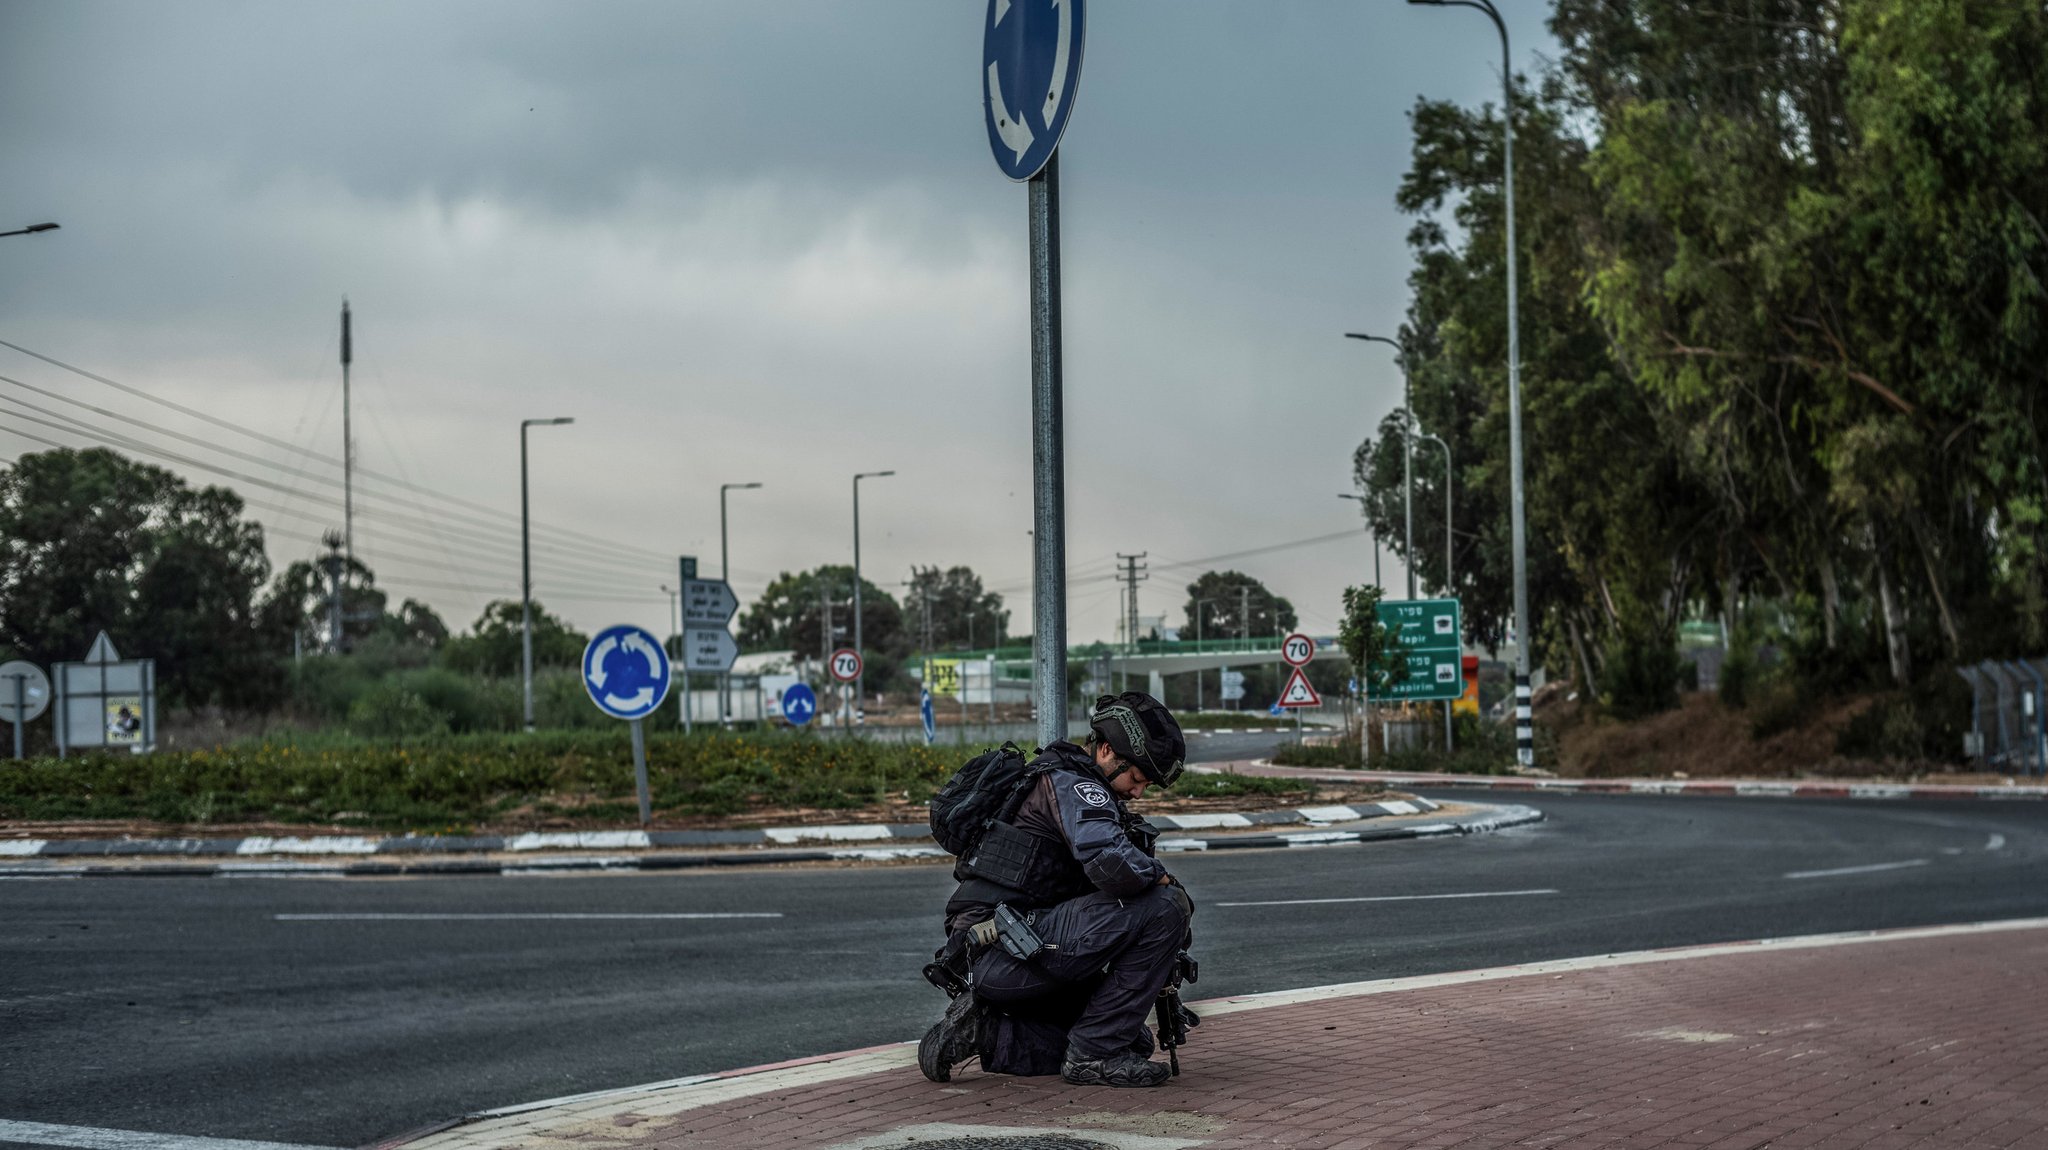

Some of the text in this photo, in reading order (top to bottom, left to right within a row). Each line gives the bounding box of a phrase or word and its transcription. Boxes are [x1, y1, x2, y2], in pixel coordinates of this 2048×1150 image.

[1398, 606, 1423, 617] ספיר
[1288, 642, 1309, 658] 70
[837, 658, 857, 672] 70
